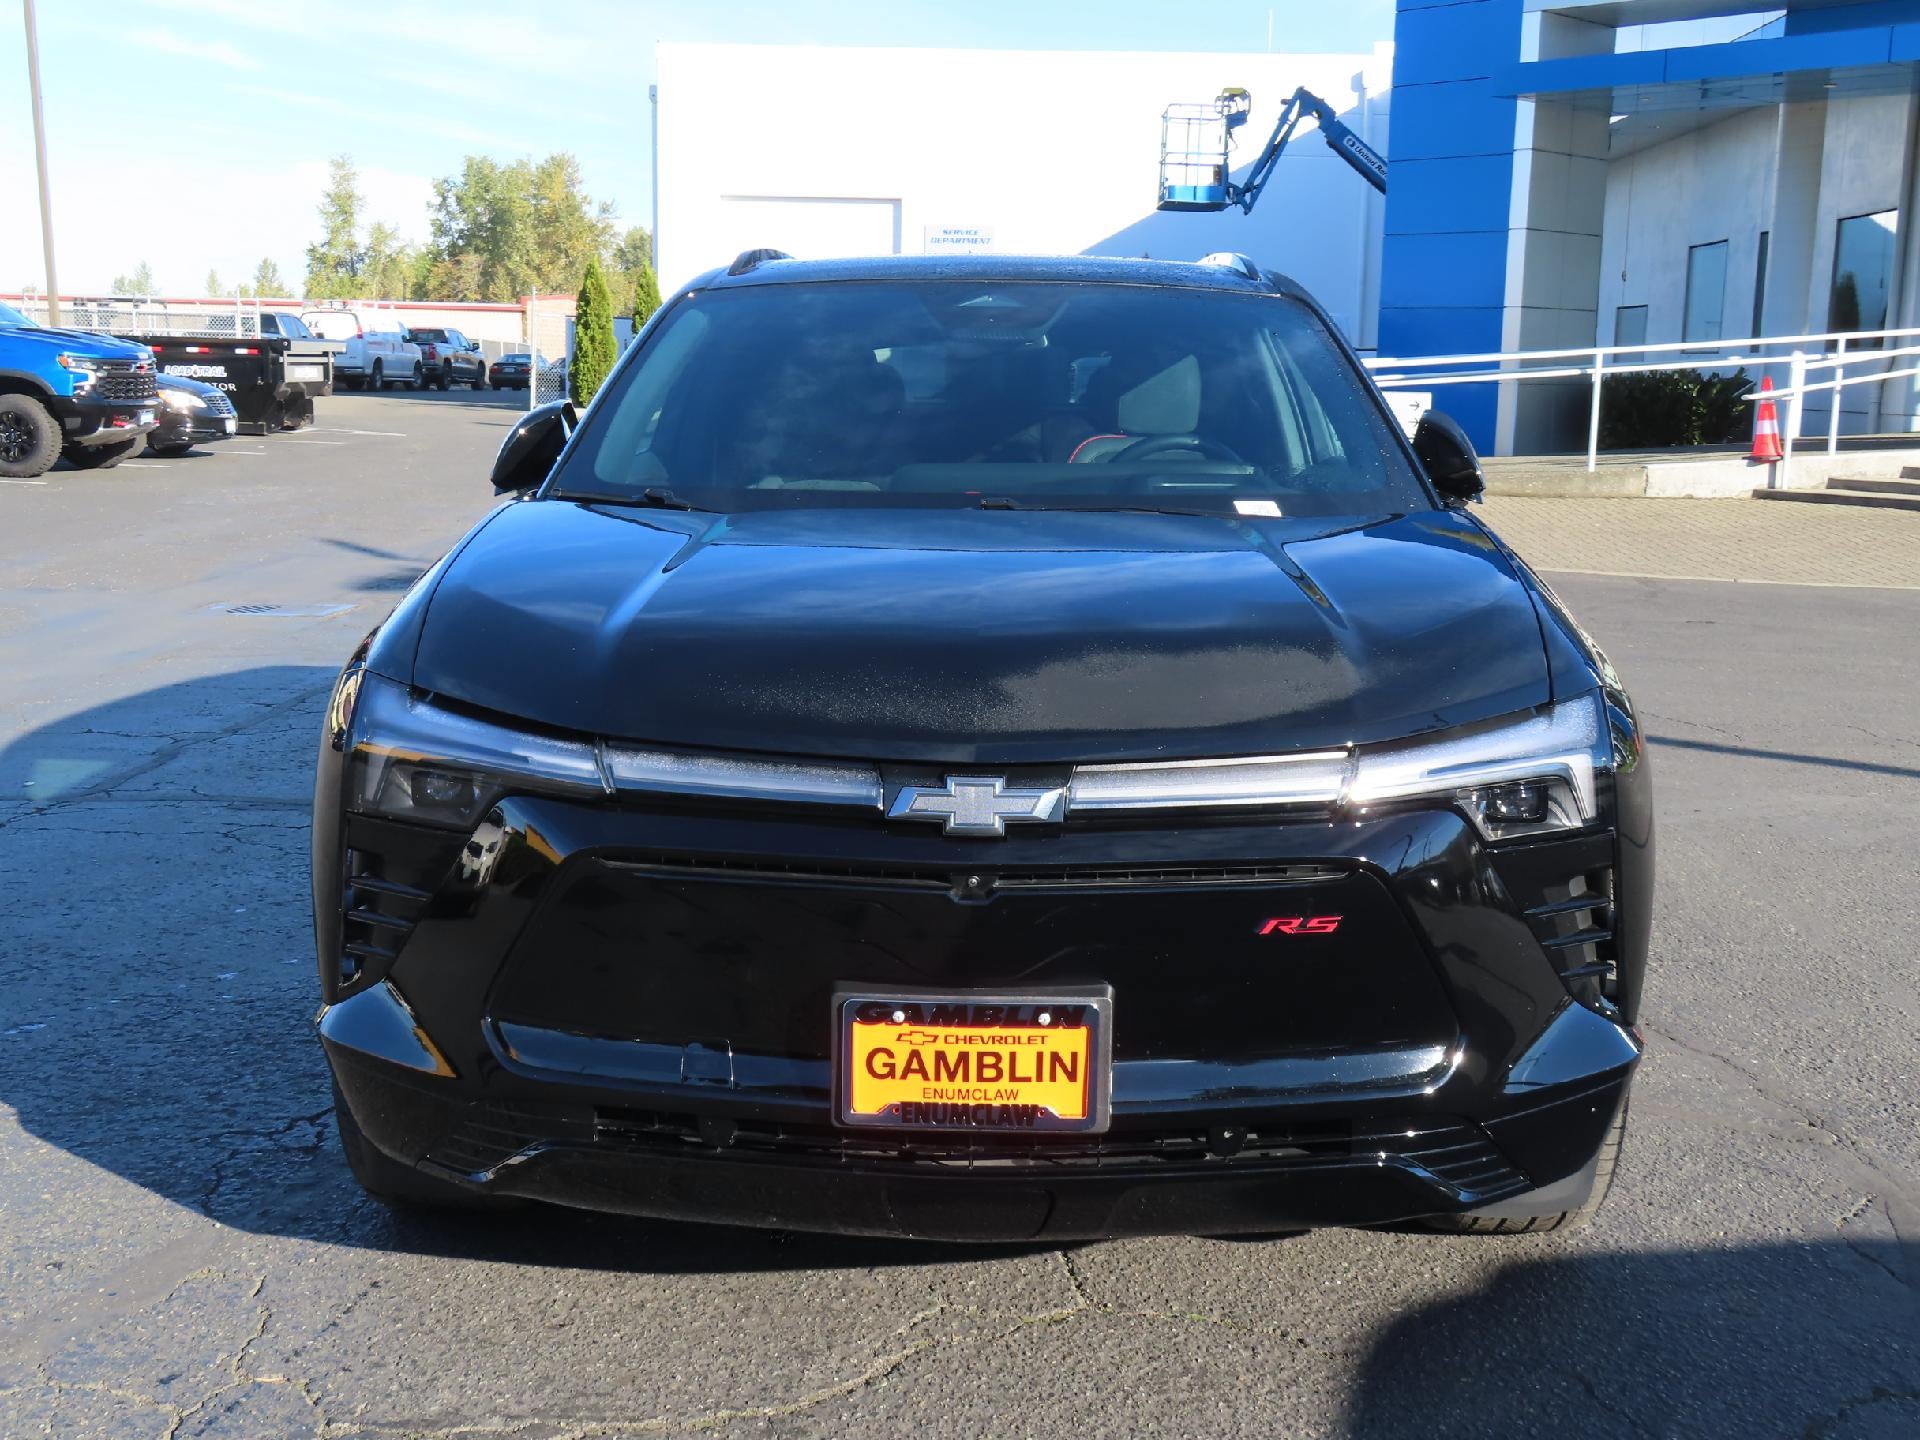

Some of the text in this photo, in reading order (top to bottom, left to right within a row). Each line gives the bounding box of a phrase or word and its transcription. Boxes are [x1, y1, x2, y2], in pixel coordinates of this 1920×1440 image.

[164, 365, 192, 377] LOAD
[209, 382, 237, 392] TOR
[1259, 916, 1344, 935] RS
[943, 1034, 1049, 1045] CHEVROLET
[865, 1047, 1078, 1083] GAMBLIN
[922, 1087, 1020, 1102] ENUMCLAW
[901, 1102, 1039, 1126] ENUMCLAW
